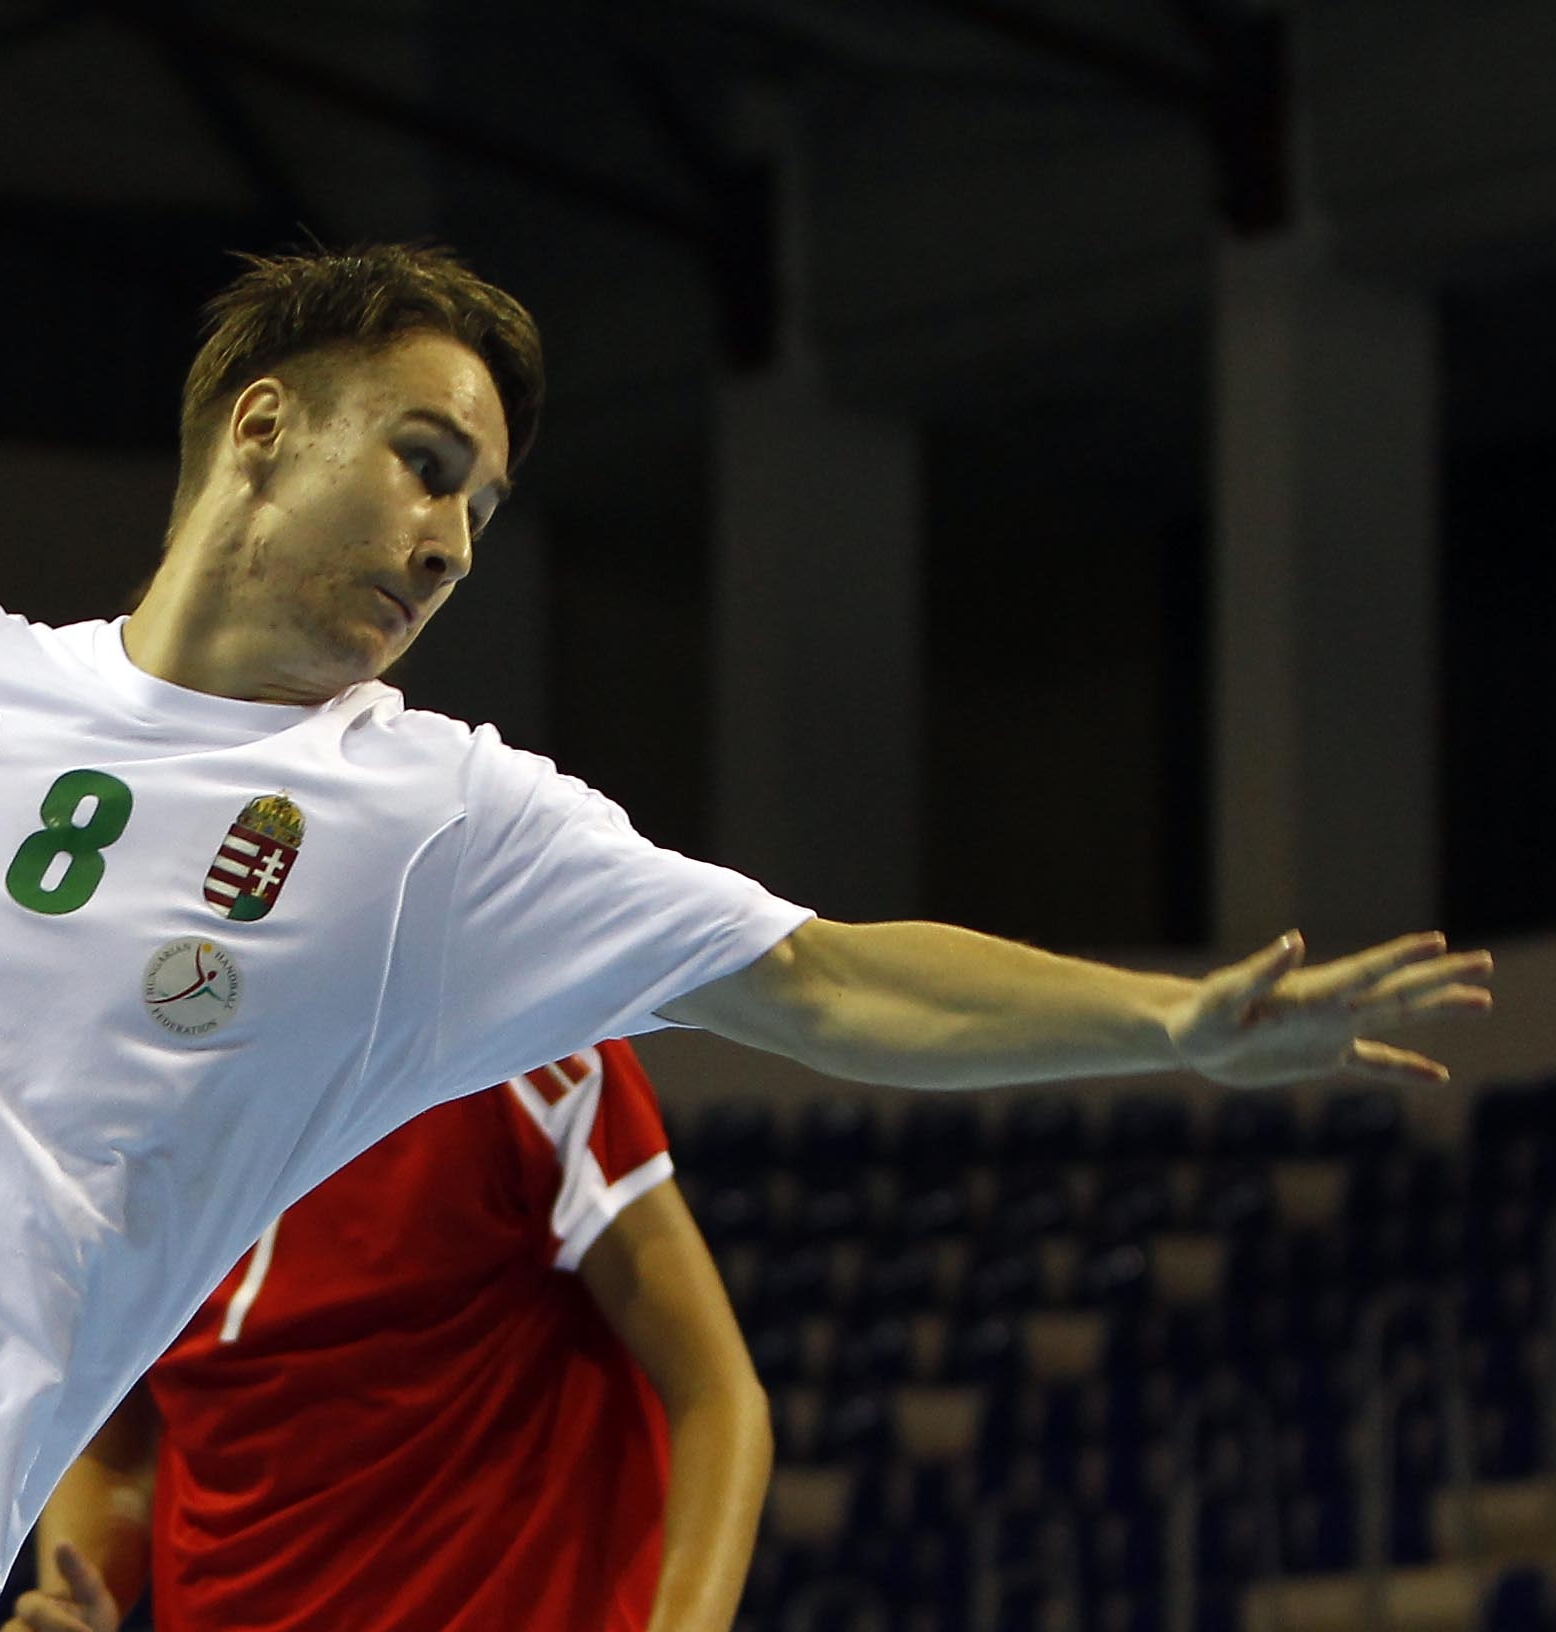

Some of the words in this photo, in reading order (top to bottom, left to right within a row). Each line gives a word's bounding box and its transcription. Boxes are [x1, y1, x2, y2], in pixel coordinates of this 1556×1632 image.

[6, 769, 133, 915] 8
[146, 943, 192, 997] HUNGARIAN
[214, 951, 239, 1009] HANDBALL
[151, 1007, 218, 1035] FEDERATION
